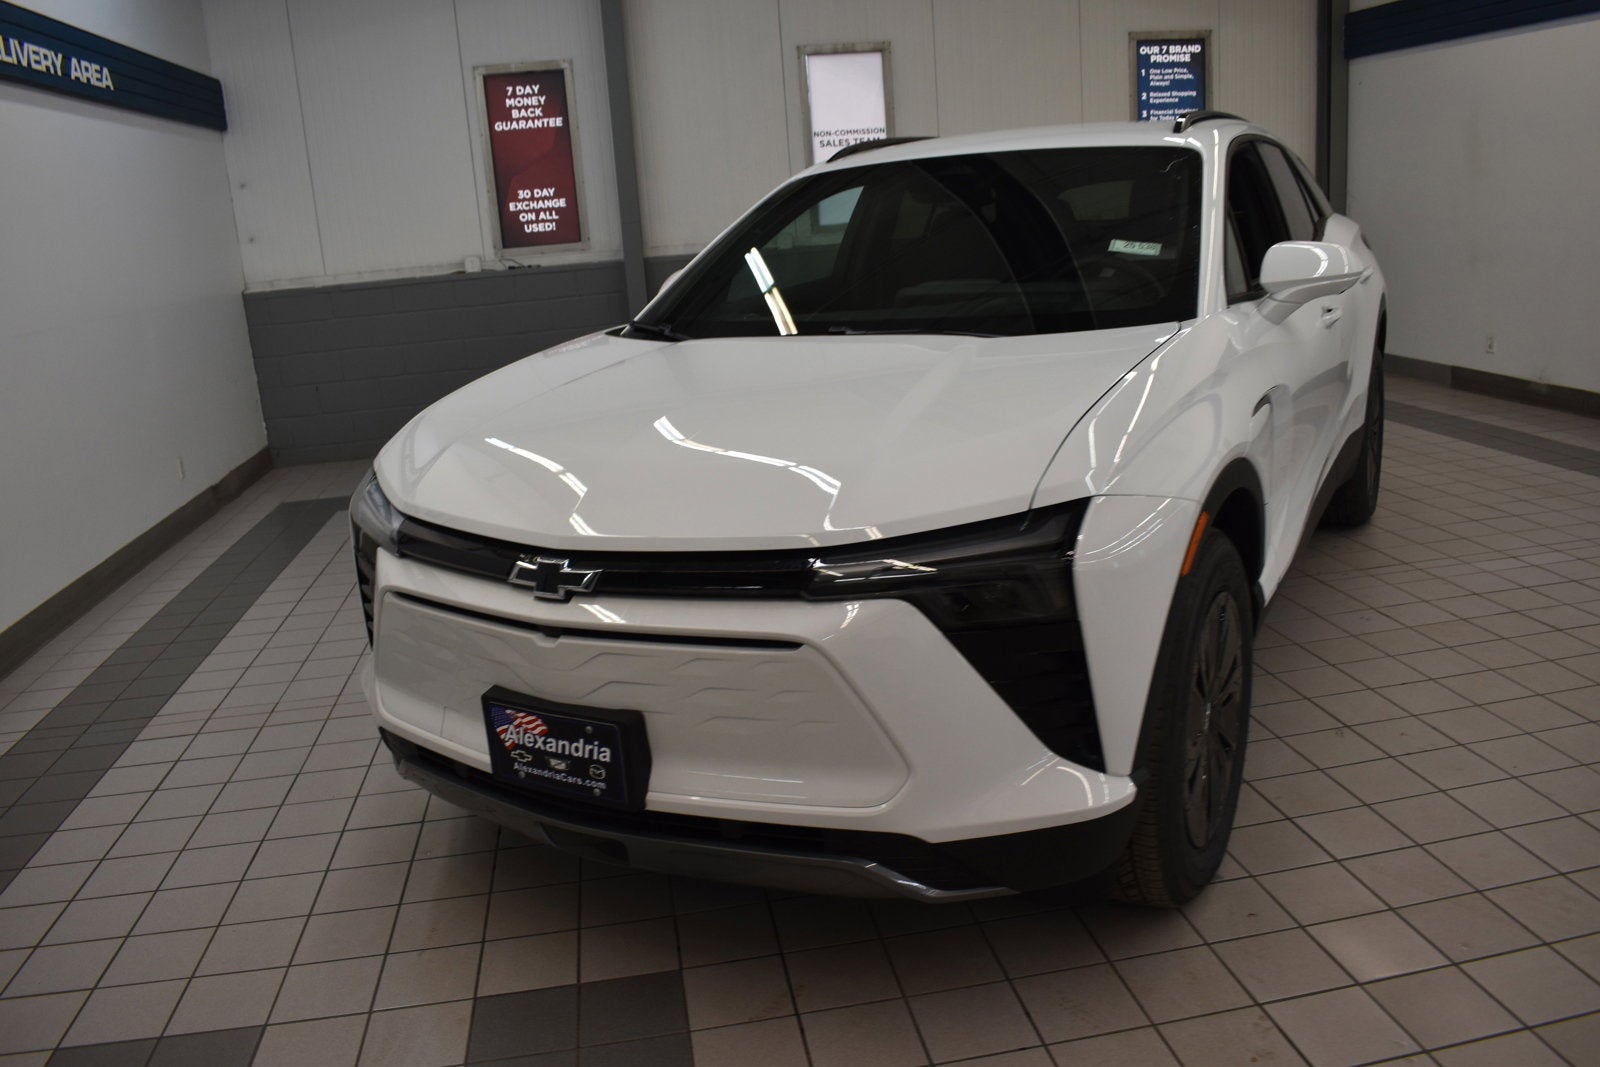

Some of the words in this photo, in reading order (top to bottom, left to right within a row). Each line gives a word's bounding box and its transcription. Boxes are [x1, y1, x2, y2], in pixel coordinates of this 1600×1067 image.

[1140, 46, 1160, 55] OUR
[1161, 45, 1167, 54] 7
[1169, 45, 1201, 53] BRAND
[0, 34, 62, 76] LIVERY
[70, 57, 114, 91] AREA
[1150, 54, 1191, 63] PROMISE
[1141, 68, 1145, 77] 1
[506, 86, 513, 96] 7
[515, 84, 540, 95] DAY
[1141, 92, 1147, 100] 2
[505, 95, 546, 108] MONEY
[511, 107, 543, 119] BACK
[1141, 110, 1147, 118] 3
[494, 117, 563, 131] GUARANTEE
[813, 127, 886, 138] NON-COMMISSION
[819, 138, 850, 148] SALES
[517, 189, 531, 199] 30
[533, 187, 555, 198] DAY
[509, 198, 567, 212] EXCHANGE
[519, 212, 536, 222] ON
[538, 210, 559, 220] ALL
[524, 222, 556, 233] USED!
[504, 724, 611, 763] Alexandria
[513, 761, 606, 790] AlexandriaCars.com
